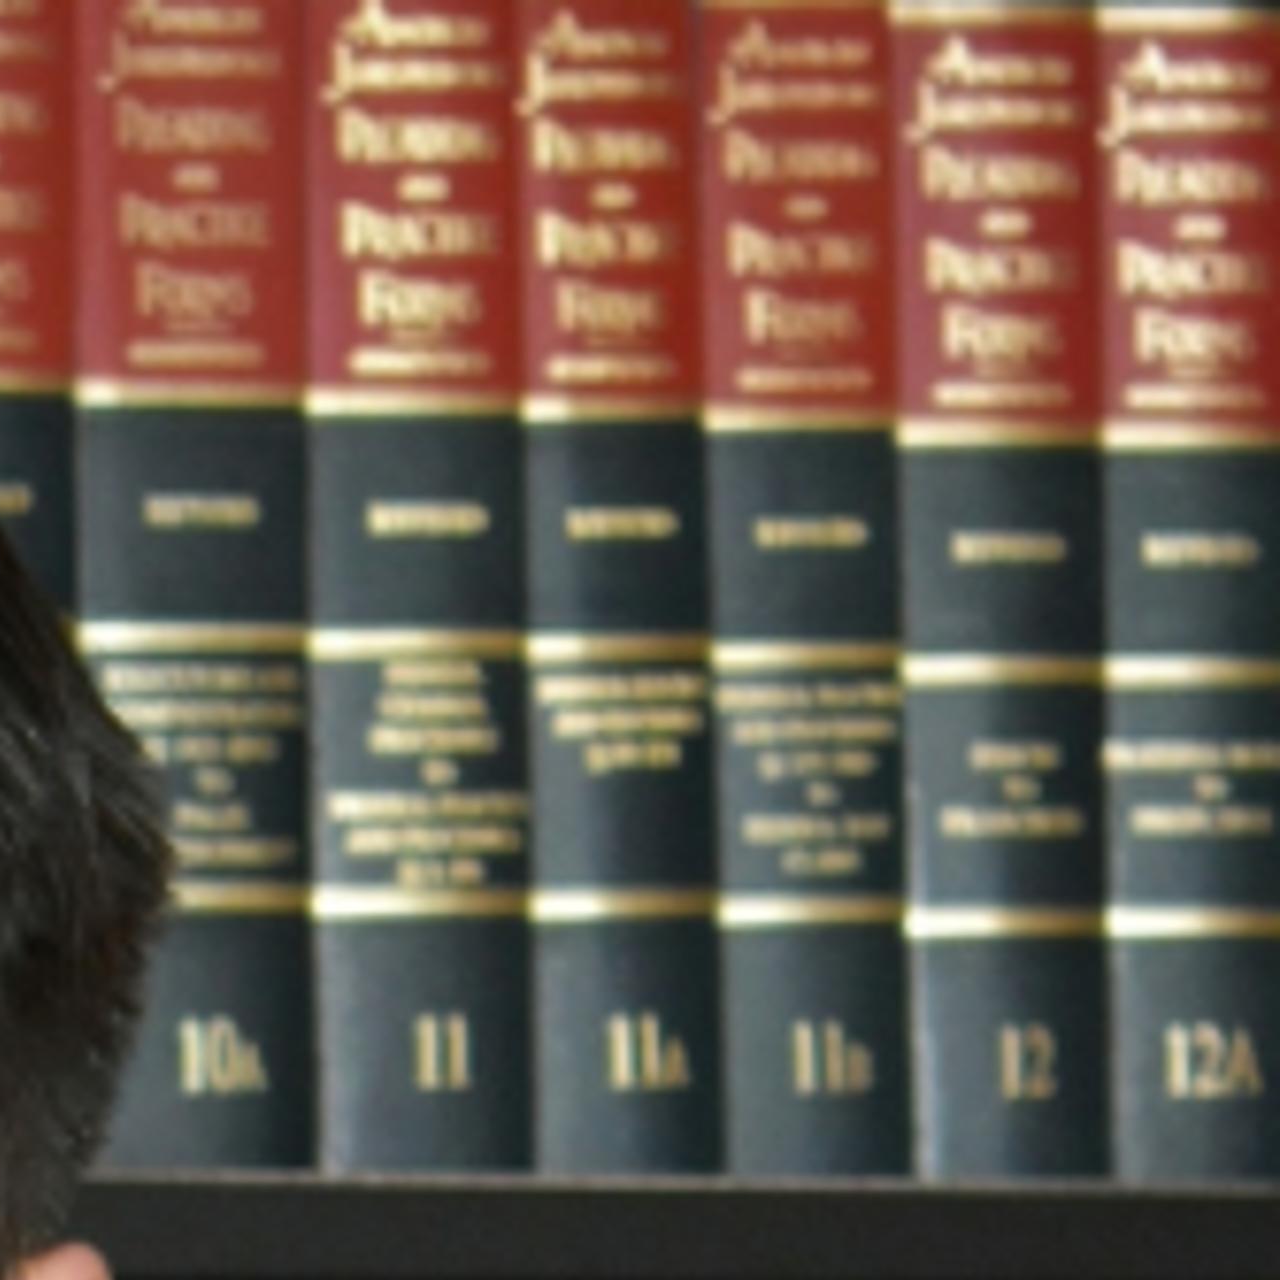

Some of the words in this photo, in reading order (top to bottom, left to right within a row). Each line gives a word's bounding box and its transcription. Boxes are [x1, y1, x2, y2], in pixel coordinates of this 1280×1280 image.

[179, 1015, 267, 1096] 10A
[414, 1011, 468, 1092] 11
[609, 1011, 689, 1092] 11A
[998, 1022, 1057, 1100] 12
[1163, 1022, 1263, 1099] 12A
